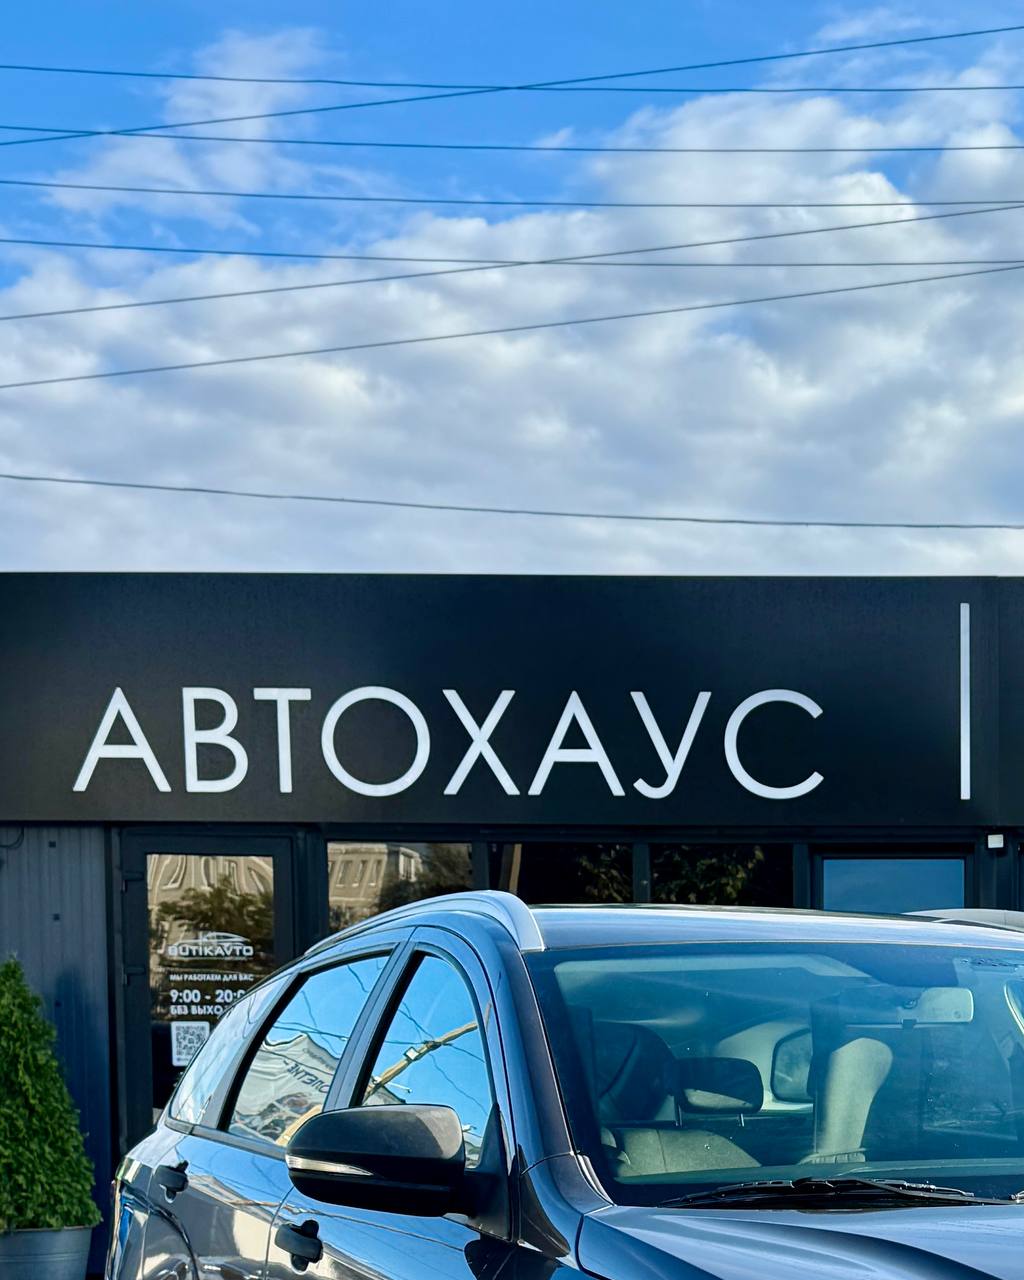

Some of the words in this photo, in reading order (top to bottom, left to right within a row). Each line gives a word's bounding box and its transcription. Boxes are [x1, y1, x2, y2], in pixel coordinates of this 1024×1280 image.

[72, 685, 825, 800] АВТОХАУС
[170, 989, 201, 1003] 9:00
[170, 1005, 188, 1015] БЕЗ
